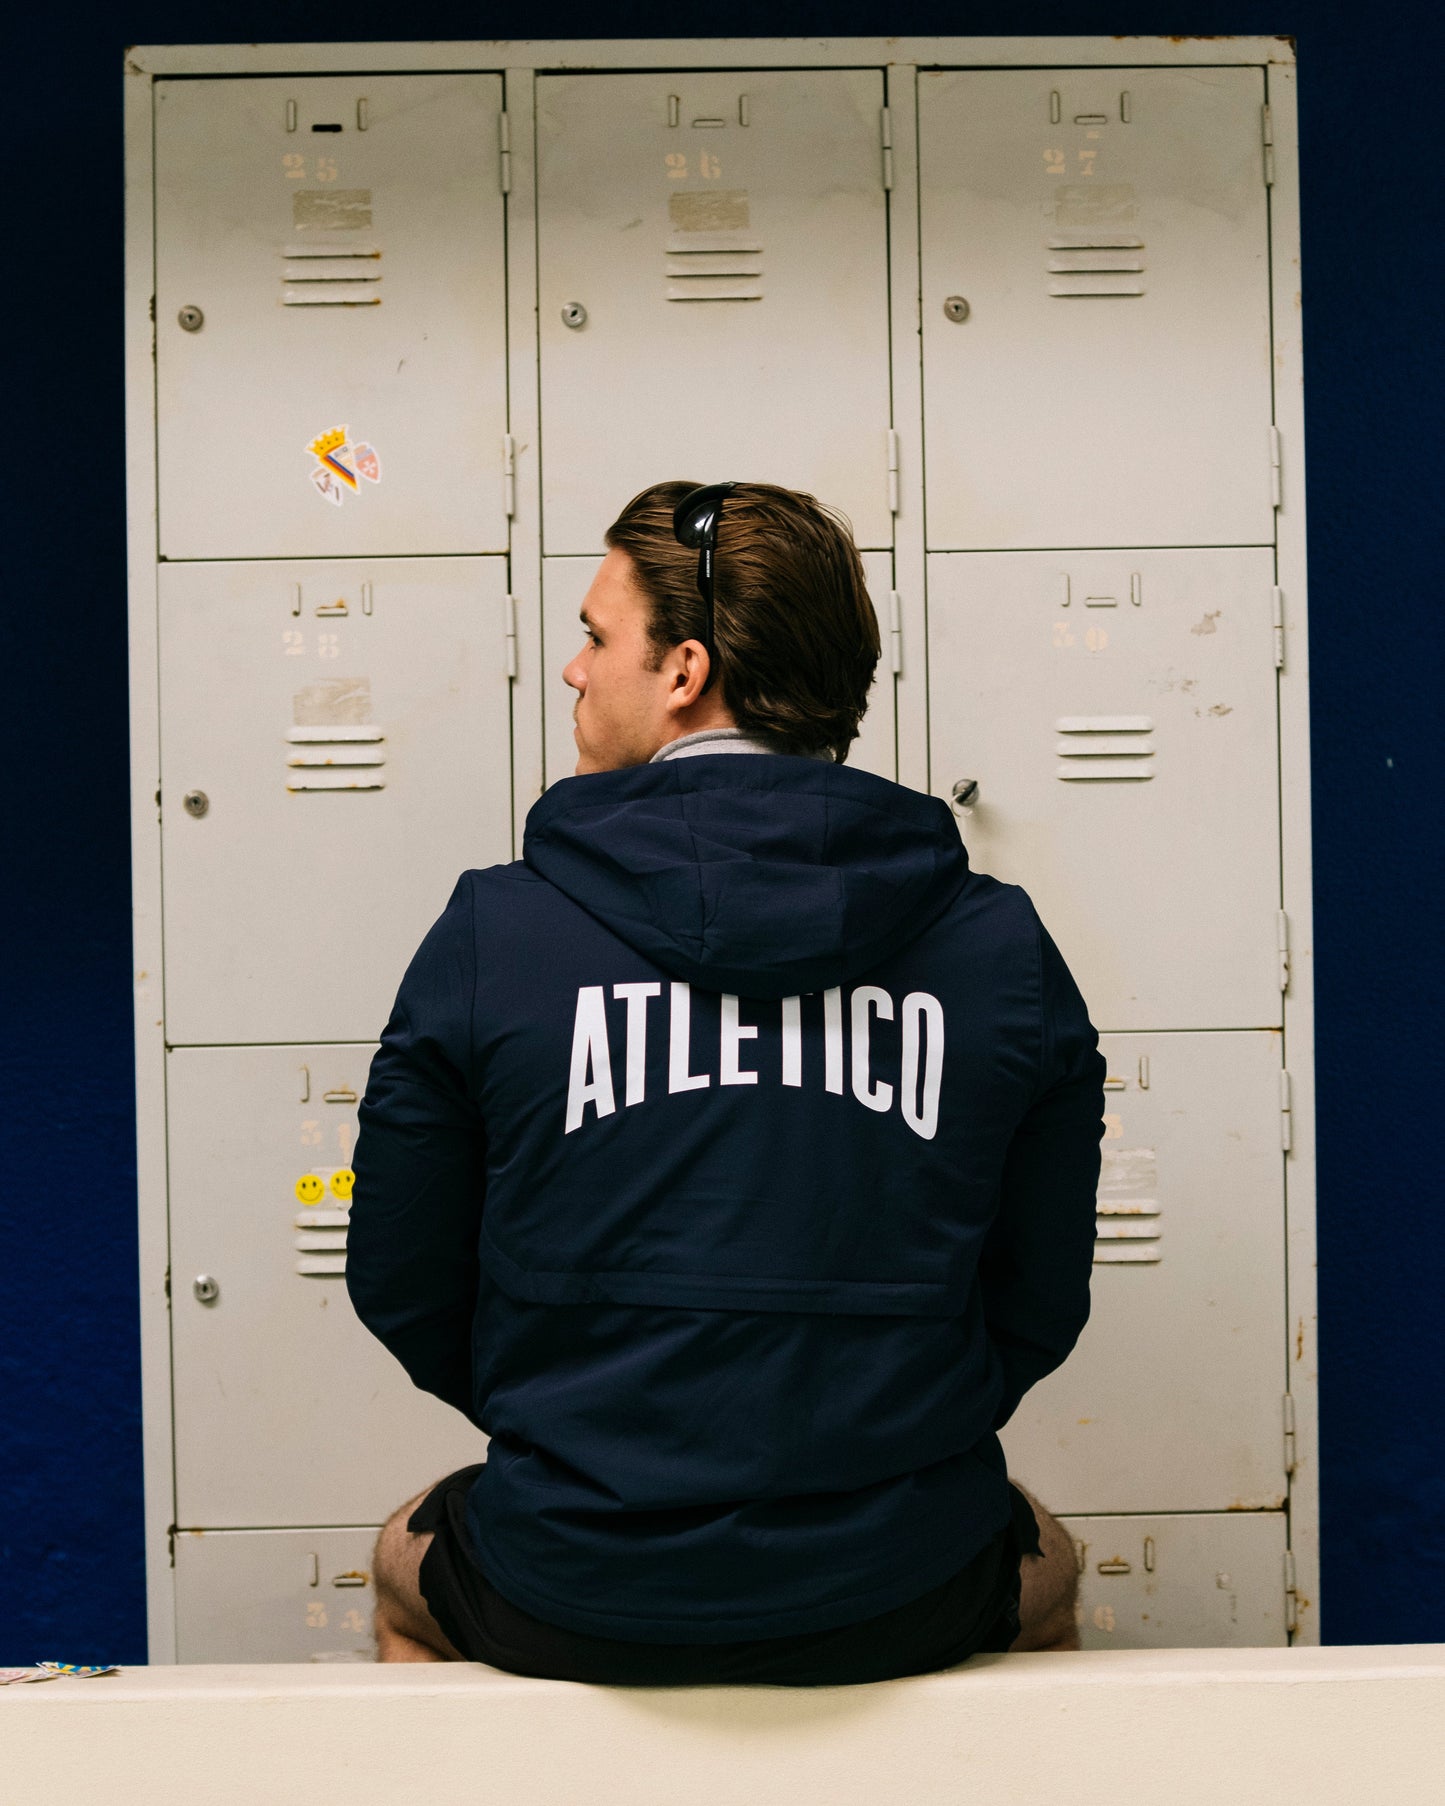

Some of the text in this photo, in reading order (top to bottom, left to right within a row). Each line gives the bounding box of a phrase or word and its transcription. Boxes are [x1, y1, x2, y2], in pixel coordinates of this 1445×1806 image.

[282, 153, 339, 182] 25
[664, 148, 722, 180] 26
[1042, 148, 1097, 176] 27
[282, 629, 340, 658] 28
[565, 981, 945, 1140] ATLETICO
